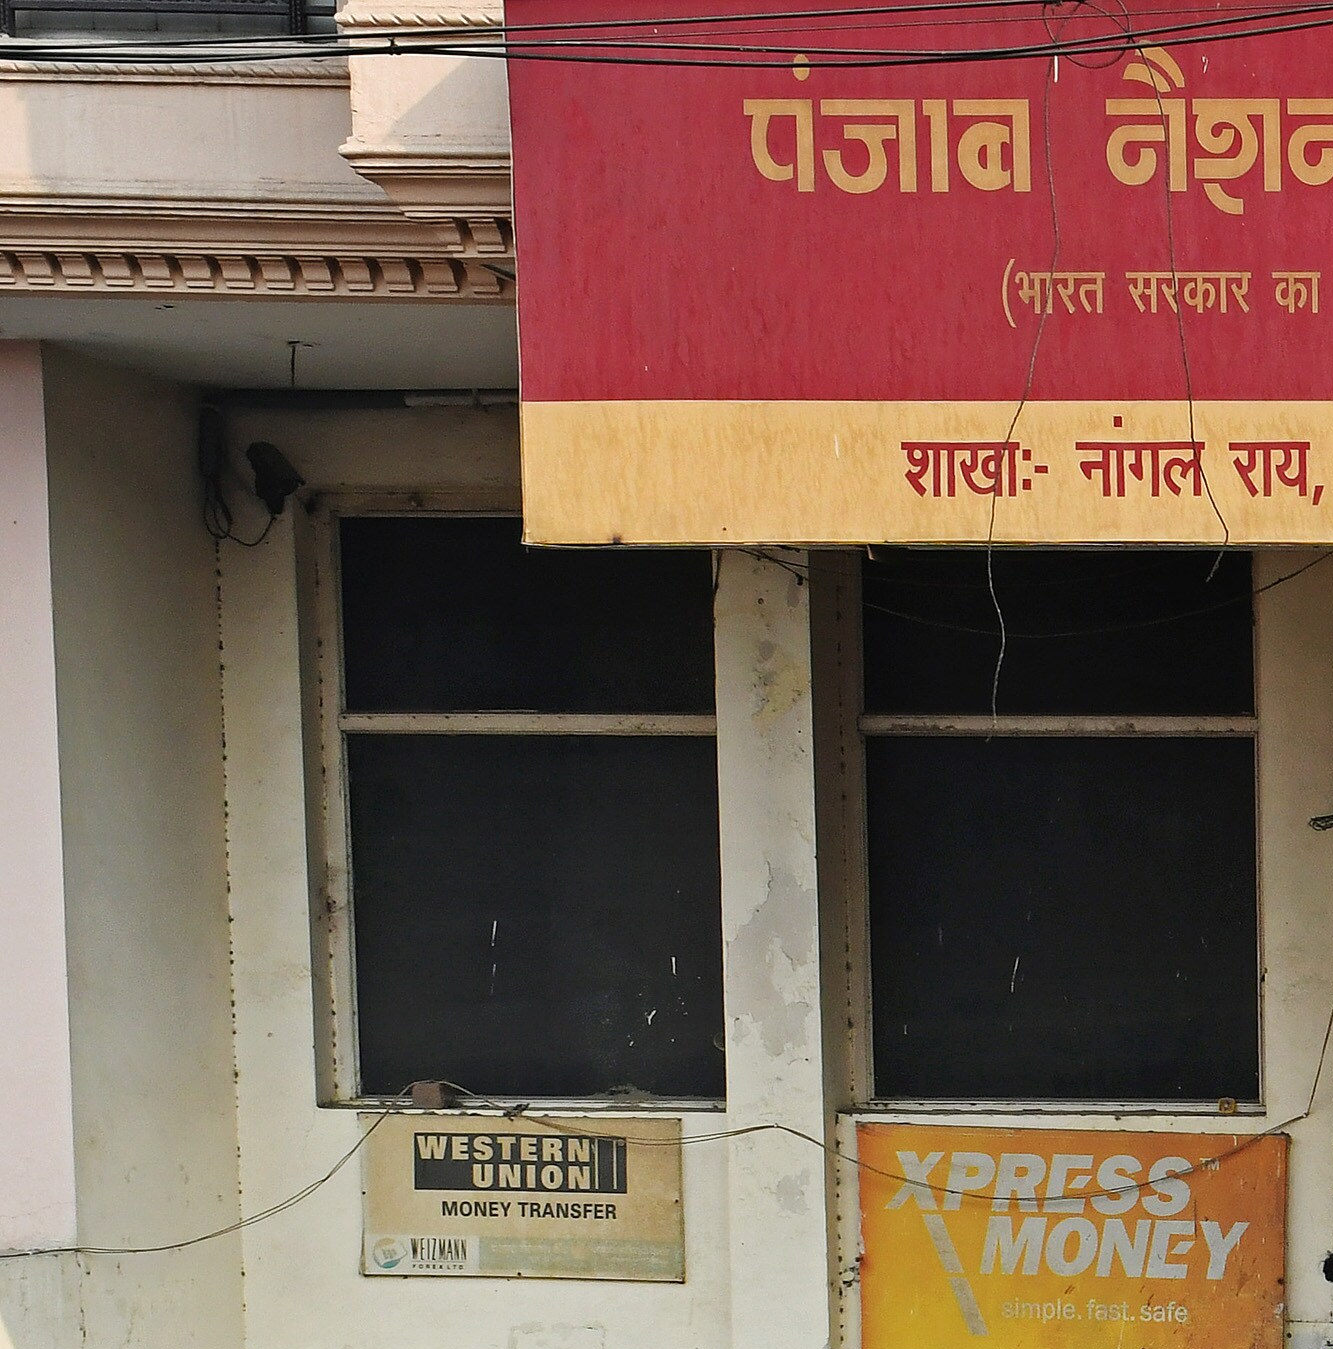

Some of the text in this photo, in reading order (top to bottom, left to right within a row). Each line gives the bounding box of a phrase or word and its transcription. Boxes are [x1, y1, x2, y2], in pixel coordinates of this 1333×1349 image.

[744, 52, 1033, 195] पंजाब
[1000, 258, 1104, 328] (भारत
[1129, 270, 1250, 317] सरकार
[1273, 270, 1320, 315] का
[1076, 416, 1201, 500] नांगल
[1231, 440, 1322, 505] राय,
[416, 1135, 590, 1163] WESTERN
[472, 1164, 590, 1189] UNION
[886, 1151, 1191, 1217] XPRESS
[442, 1201, 617, 1220] MONEY TRANSFER
[410, 1237, 467, 1261] WEIZMANN
[979, 1216, 1250, 1280] MONEY
[1002, 1299, 1189, 1324] simple. fast. safe
